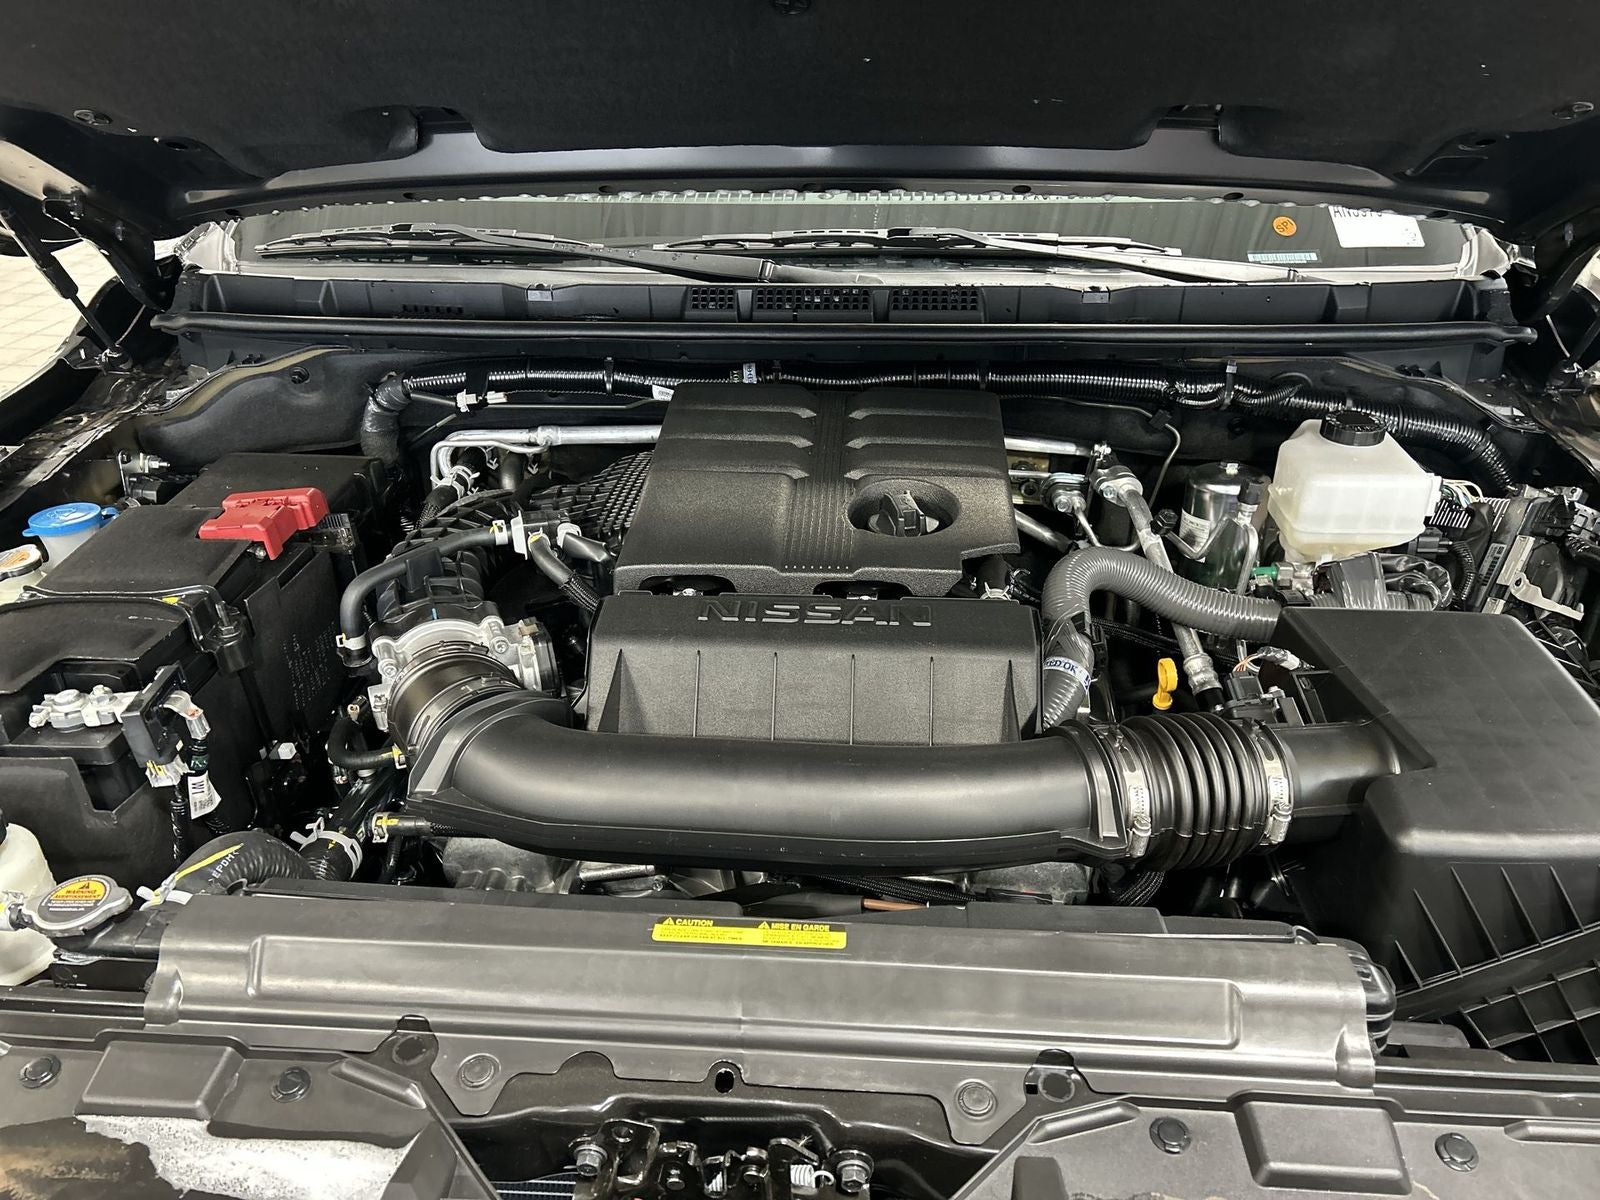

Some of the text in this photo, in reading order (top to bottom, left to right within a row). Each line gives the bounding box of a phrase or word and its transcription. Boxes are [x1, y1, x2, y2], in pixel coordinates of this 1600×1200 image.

[697, 600, 932, 627] NISSAN
[675, 918, 714, 927] CAUTION
[802, 924, 830, 932] GARDE
